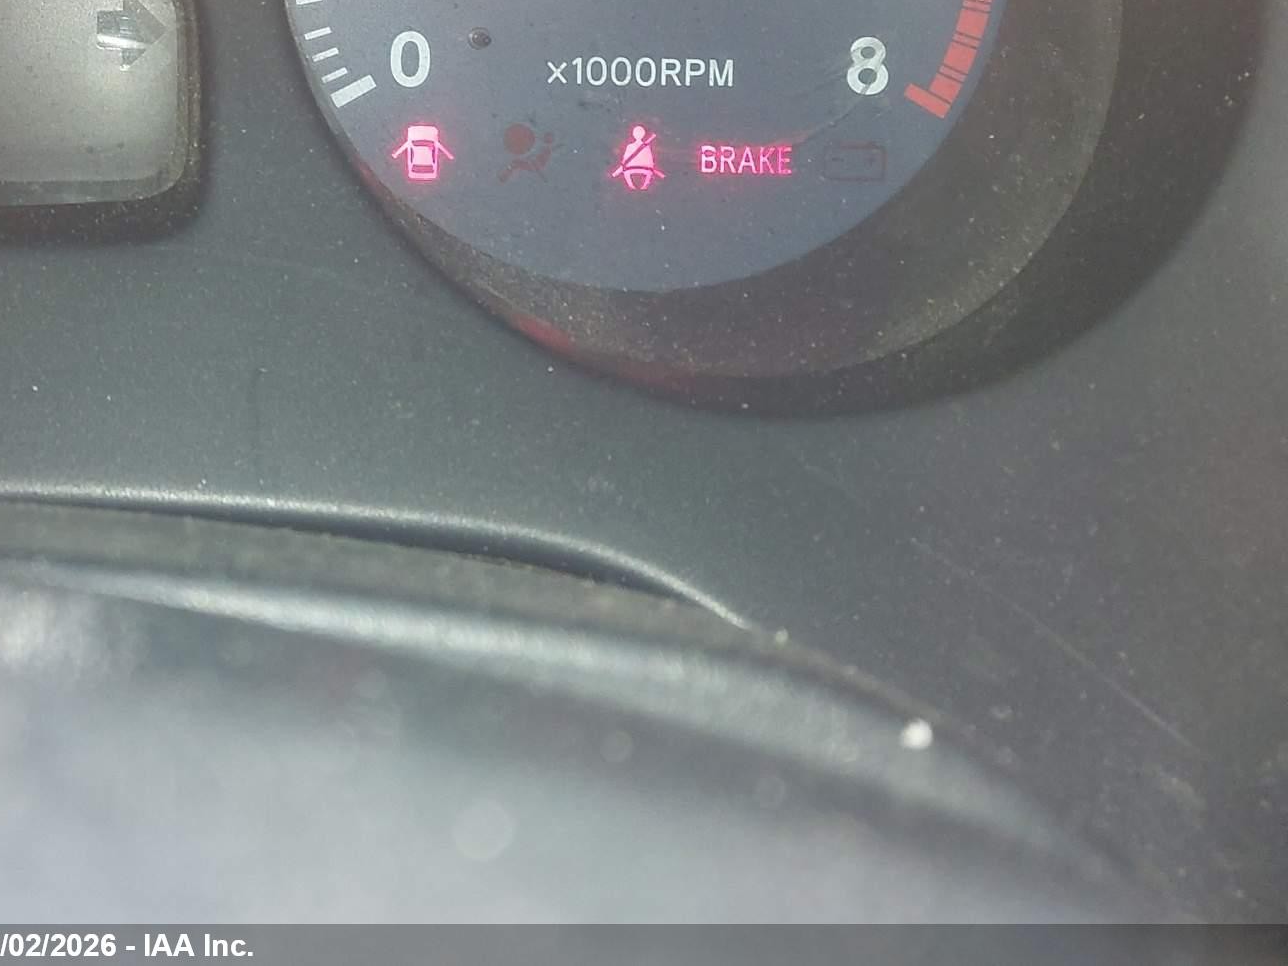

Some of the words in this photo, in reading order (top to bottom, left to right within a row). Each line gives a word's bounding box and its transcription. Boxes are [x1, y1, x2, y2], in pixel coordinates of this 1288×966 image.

[391, 31, 430, 87] 0
[847, 37, 888, 95] 8
[700, 146, 792, 174] BRAKE
